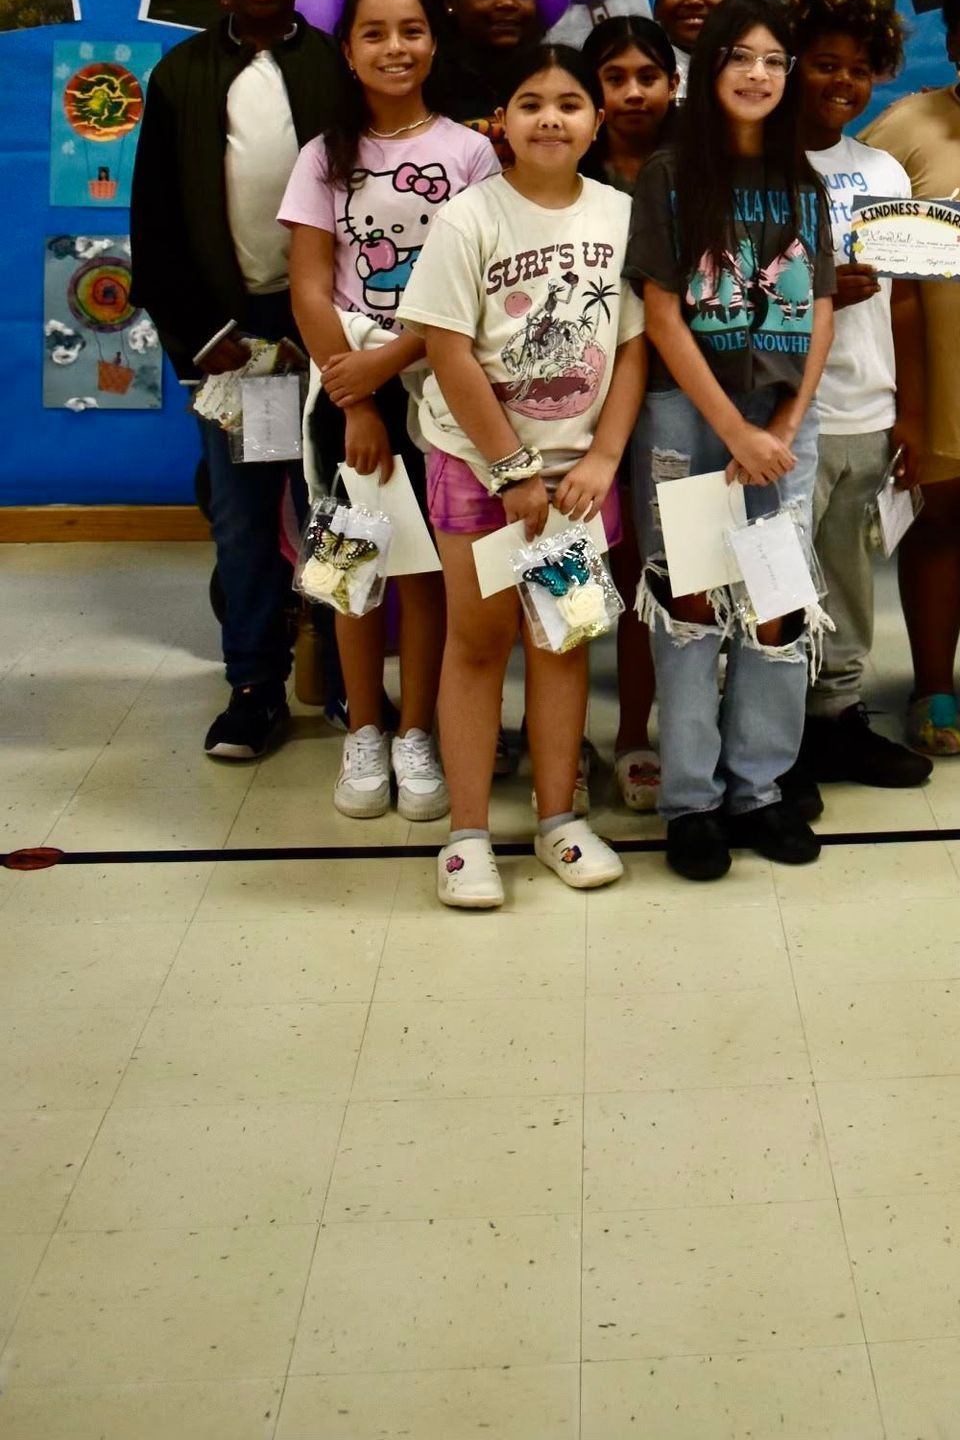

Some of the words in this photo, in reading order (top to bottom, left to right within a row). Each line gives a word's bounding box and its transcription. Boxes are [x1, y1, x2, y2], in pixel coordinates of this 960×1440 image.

[861, 202, 920, 222] KINDNESS
[486, 243, 575, 295] SURF'S
[582, 242, 614, 269] UP
